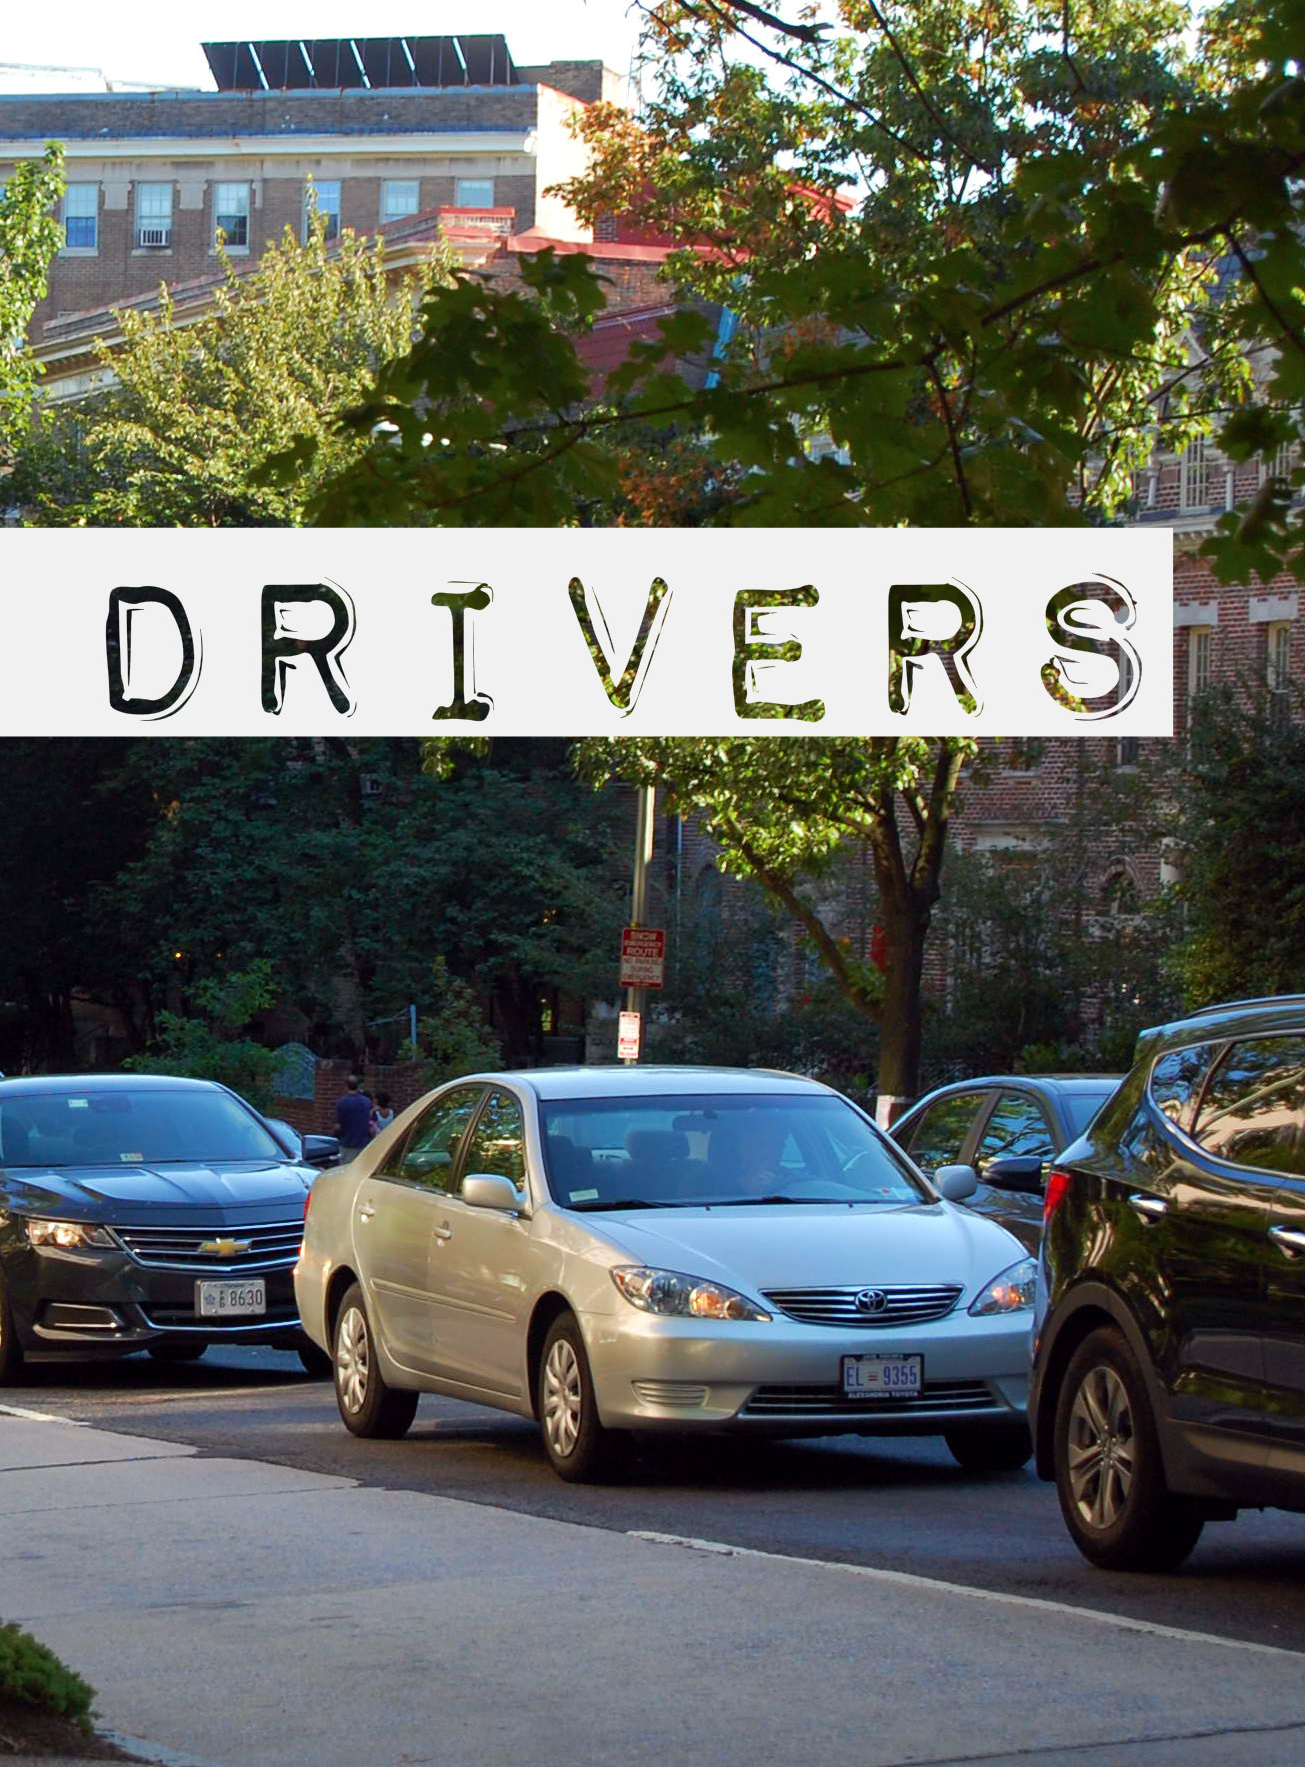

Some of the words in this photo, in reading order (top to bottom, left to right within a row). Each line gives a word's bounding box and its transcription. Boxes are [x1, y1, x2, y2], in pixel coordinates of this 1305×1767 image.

[629, 931, 657, 940] SNOW
[624, 940, 662, 948] EMERGENCY
[626, 947, 660, 957] ROUTE
[624, 957, 634, 965] NO
[635, 958, 662, 966] PARKING
[630, 966, 654, 974] DURING
[623, 973, 661, 982] EMERGENCY
[230, 1289, 262, 1306] 8630
[846, 1366, 864, 1386] EL
[883, 1365, 917, 1385] 9355
